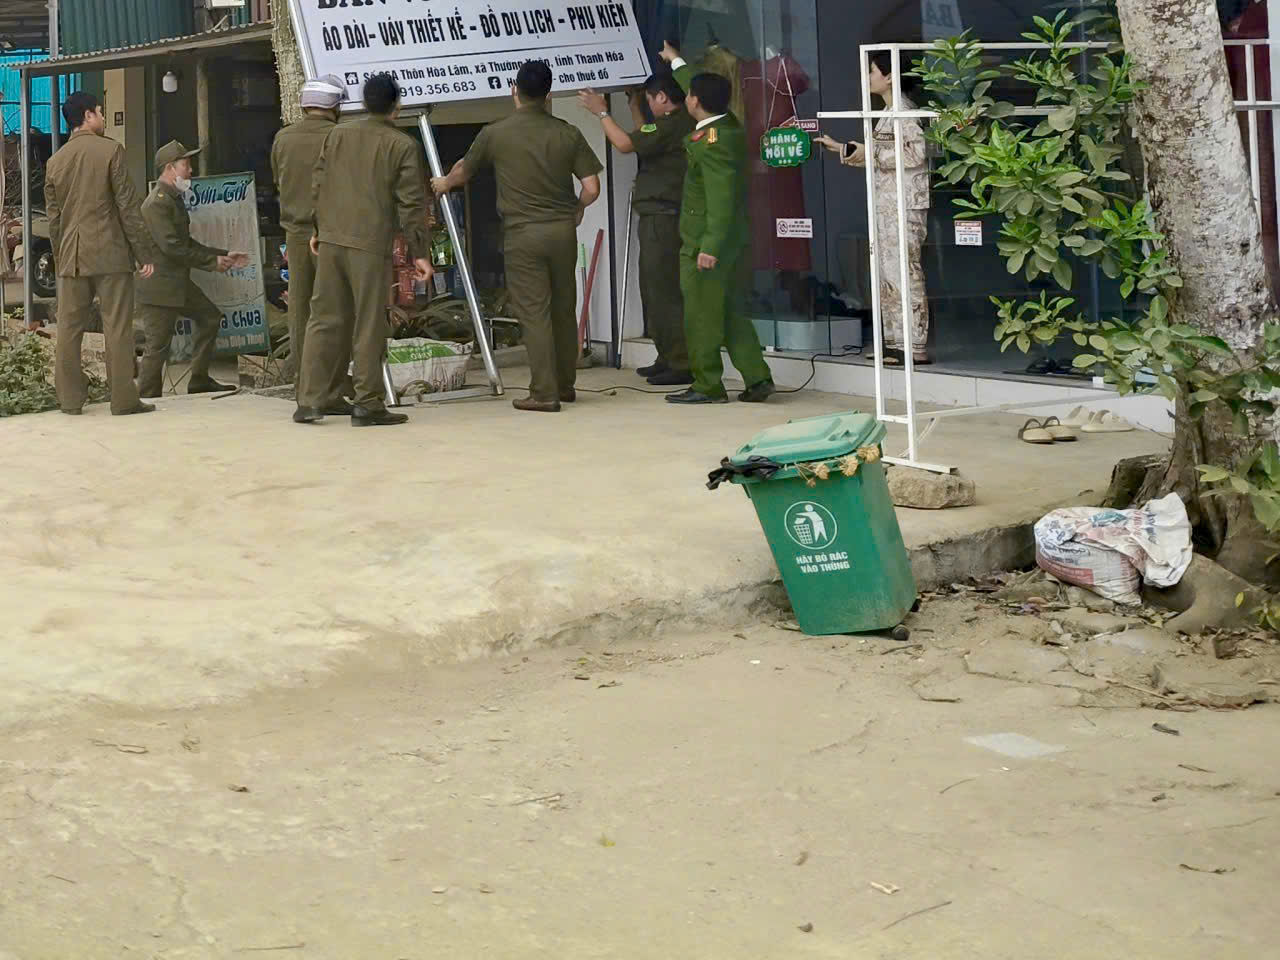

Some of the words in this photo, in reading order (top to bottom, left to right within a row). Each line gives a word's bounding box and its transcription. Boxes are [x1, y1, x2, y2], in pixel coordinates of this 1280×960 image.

[322, 21, 343, 52] ÁO
[378, 17, 406, 46] VÁY
[406, 9, 446, 44] THIẾT
[446, 7, 468, 41] KẾ
[479, 4, 501, 39] ĐỒ
[501, 11, 522, 36] DU
[523, 8, 556, 39] LỊCH
[567, 5, 597, 34] PHỤ
[596, 0, 629, 33] KIỆN
[400, 67, 425, 81] Thôn
[426, 65, 446, 79] Hòa
[475, 61, 487, 74] xã
[574, 52, 604, 66] Thanh
[605, 49, 625, 62] Hóa
[559, 72, 576, 84] cho
[400, 80, 477, 98] 919.356.683
[814, 552, 828, 563] BỎ
[800, 564, 818, 573] VÀO
[820, 560, 850, 571] THÙNG
